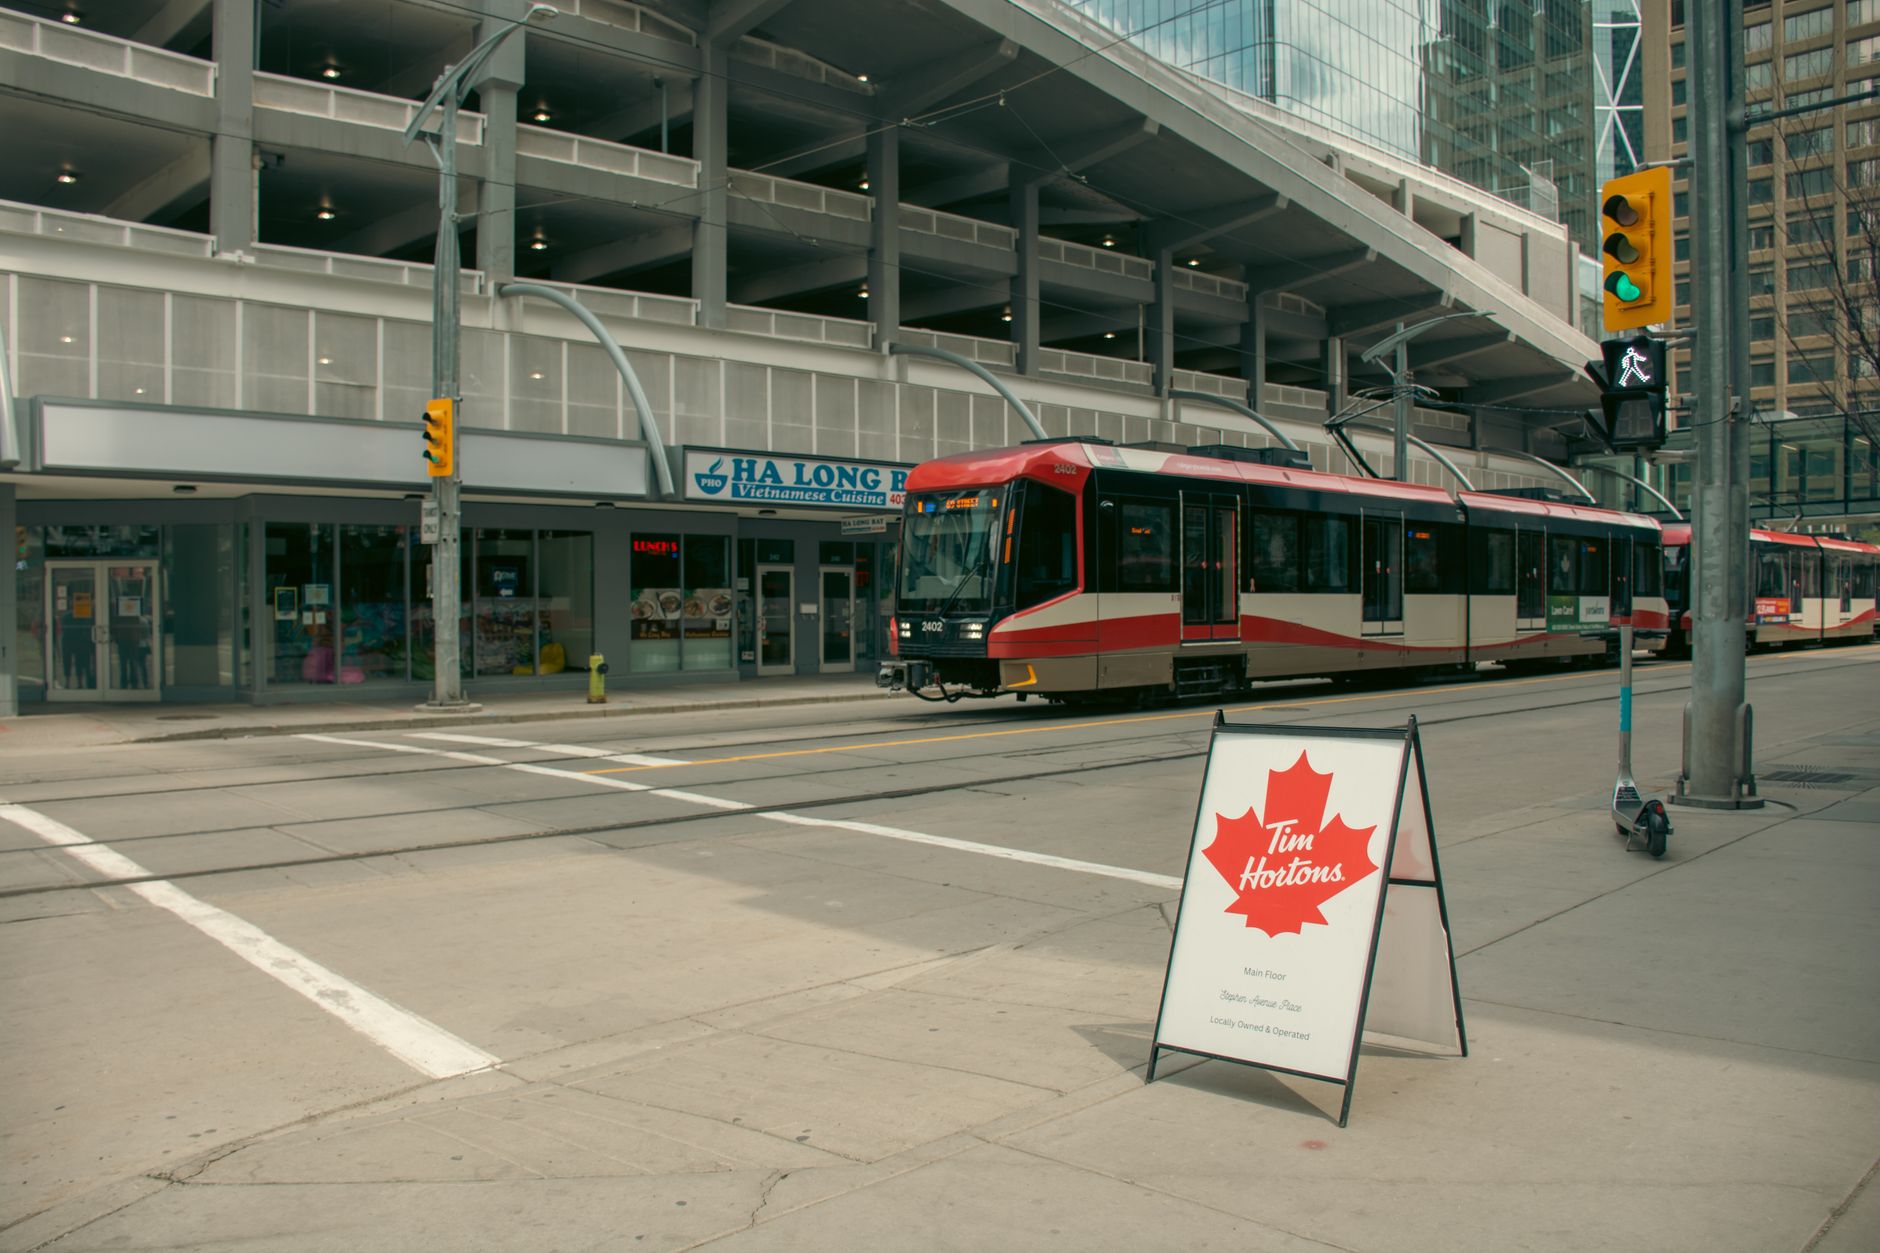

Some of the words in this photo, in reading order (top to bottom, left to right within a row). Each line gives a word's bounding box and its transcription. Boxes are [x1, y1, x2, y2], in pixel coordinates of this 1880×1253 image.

[732, 458, 783, 485] HA
[794, 463, 881, 490] LONG
[1054, 464, 1078, 475] 2402
[700, 479, 722, 488] PHO
[737, 484, 826, 501] Vietnamese
[831, 490, 884, 505] Cuisine
[921, 620, 943, 632] 2402
[1265, 819, 1314, 855] Tim
[1239, 855, 1343, 891] Hortons
[1243, 967, 1263, 977] Main
[1264, 969, 1287, 981] Floor
[1219, 989, 1247, 1003] Stephen
[1249, 995, 1277, 1008] Avenue
[1278, 999, 1303, 1013] Place
[1210, 1016, 1236, 1029] Locally
[1237, 1020, 1264, 1032] Owned
[1265, 1025, 1271, 1034] &
[1272, 1026, 1310, 1041] Operated
